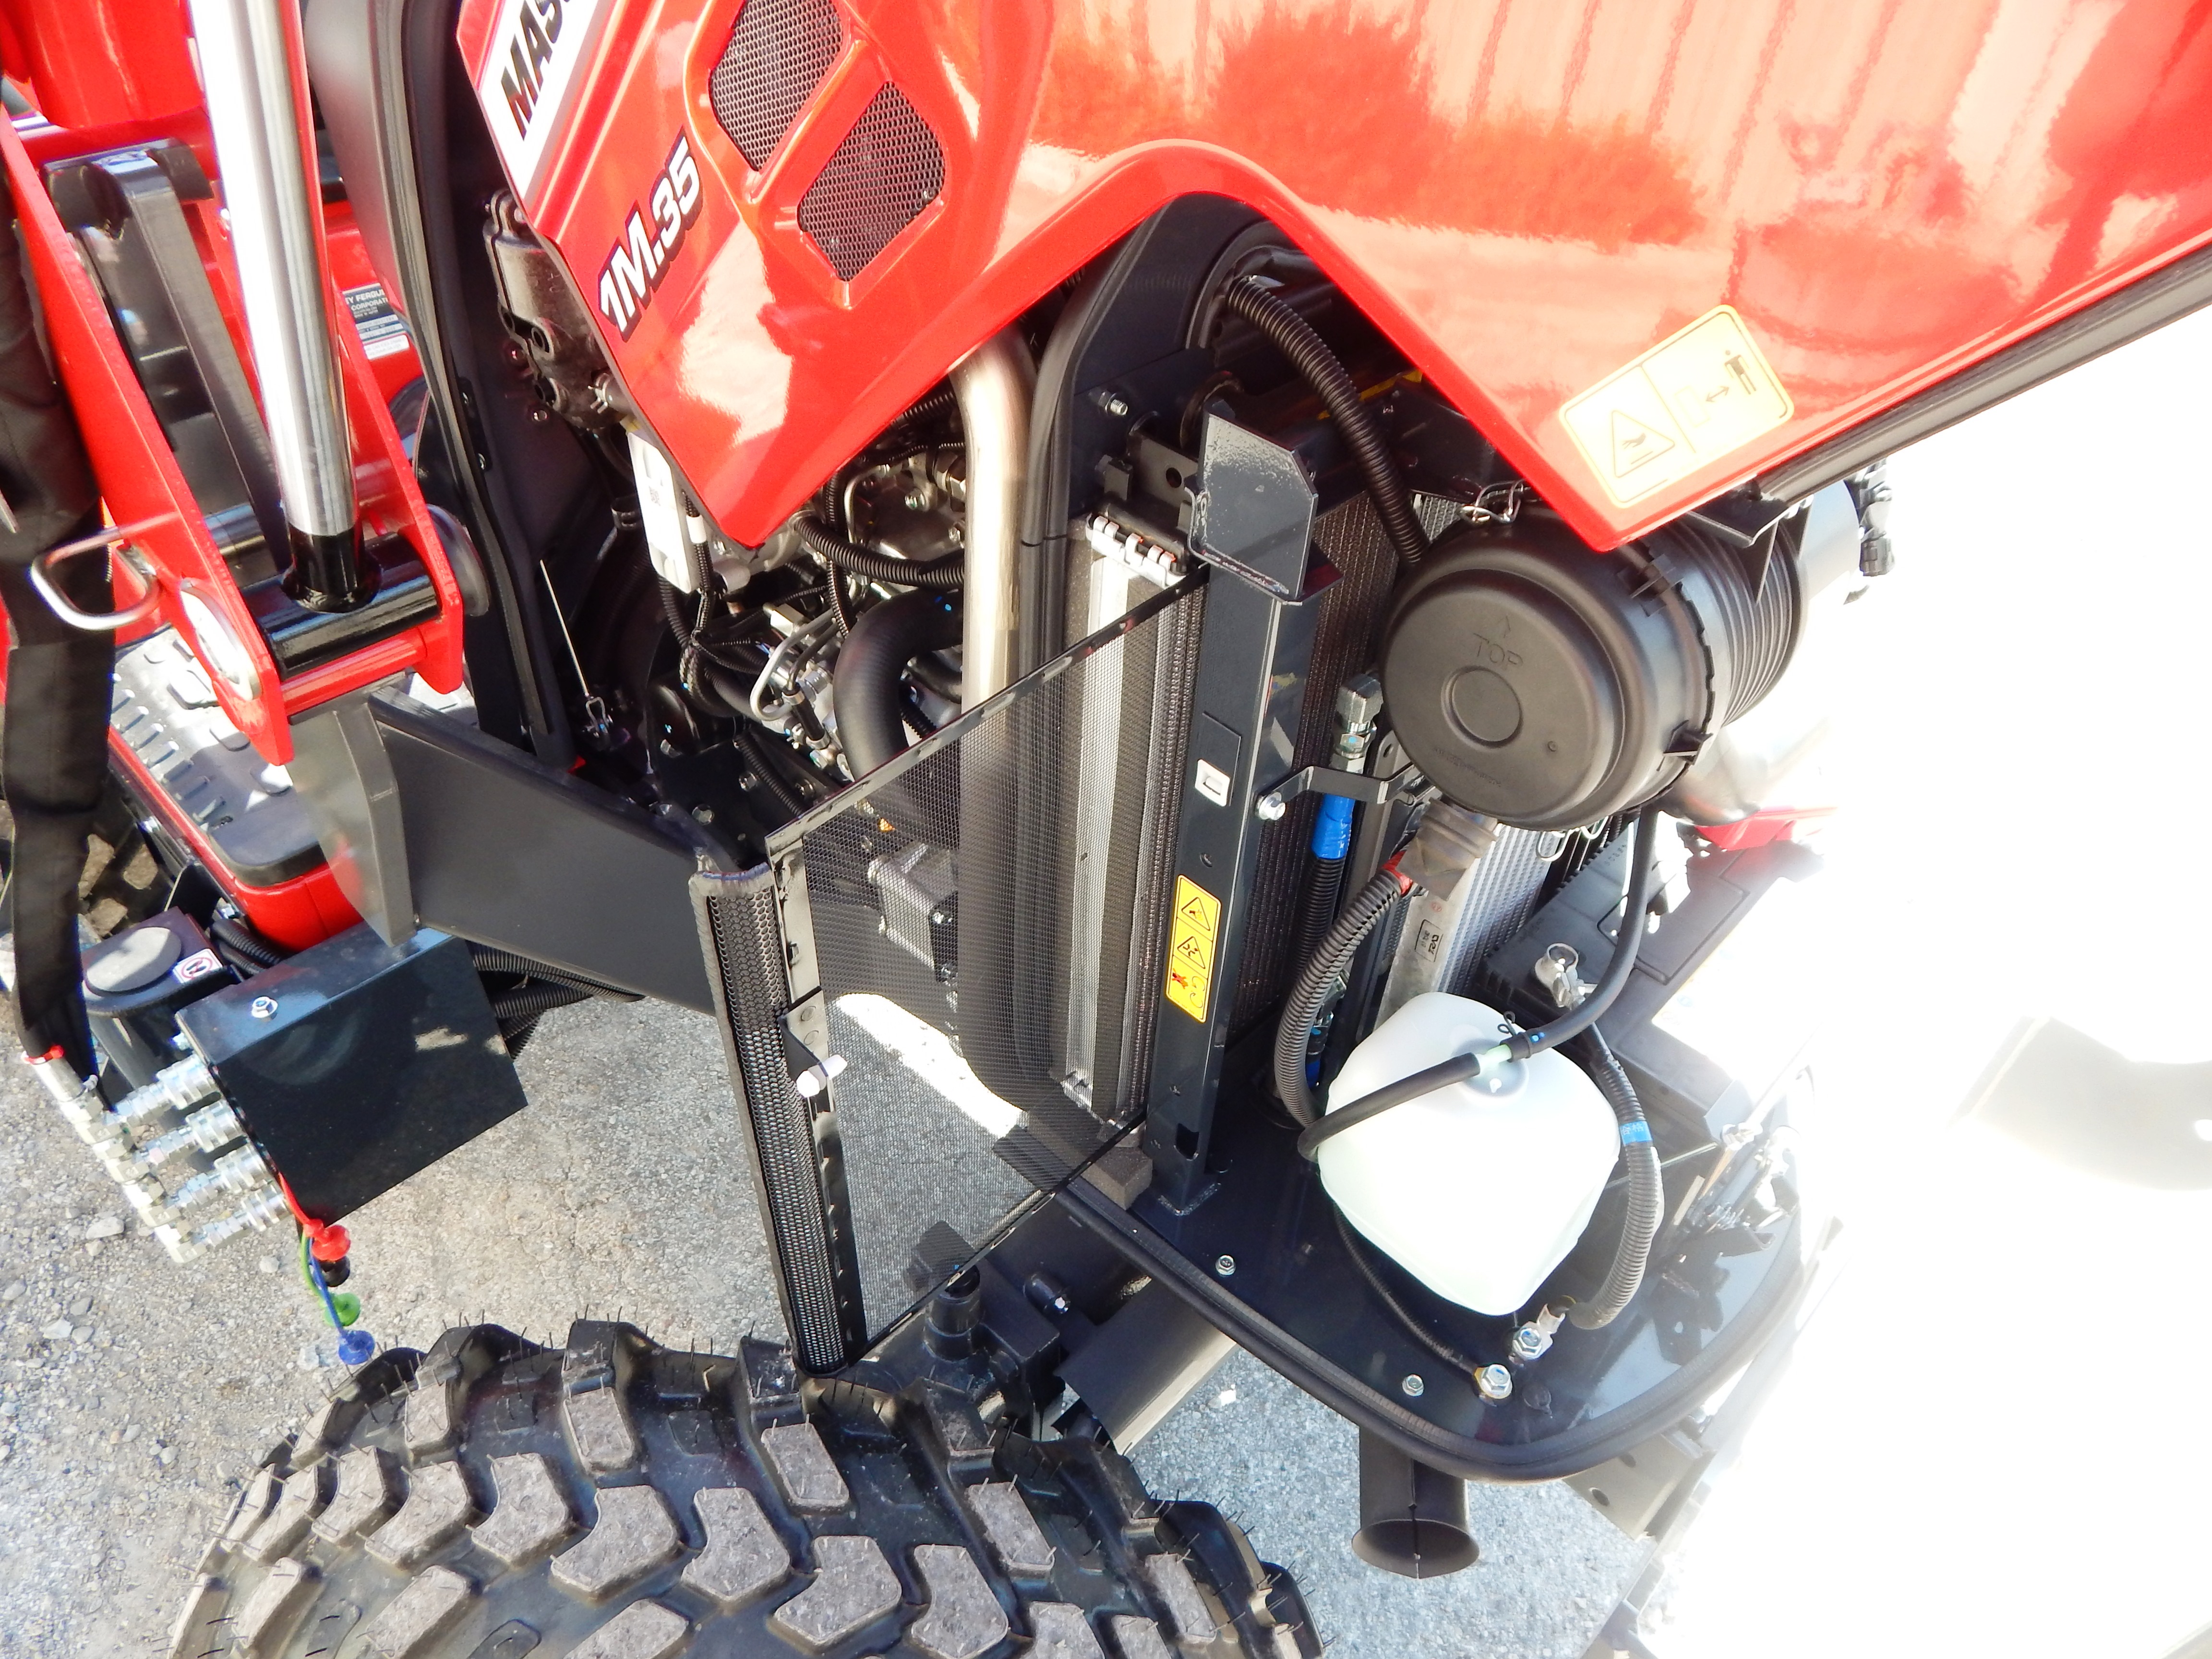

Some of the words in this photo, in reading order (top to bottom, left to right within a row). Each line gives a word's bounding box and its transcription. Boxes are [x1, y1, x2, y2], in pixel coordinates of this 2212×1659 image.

[501, 0, 570, 141] MAS
[599, 131, 701, 337] 1M.35
[1473, 633, 1524, 670] TOP
